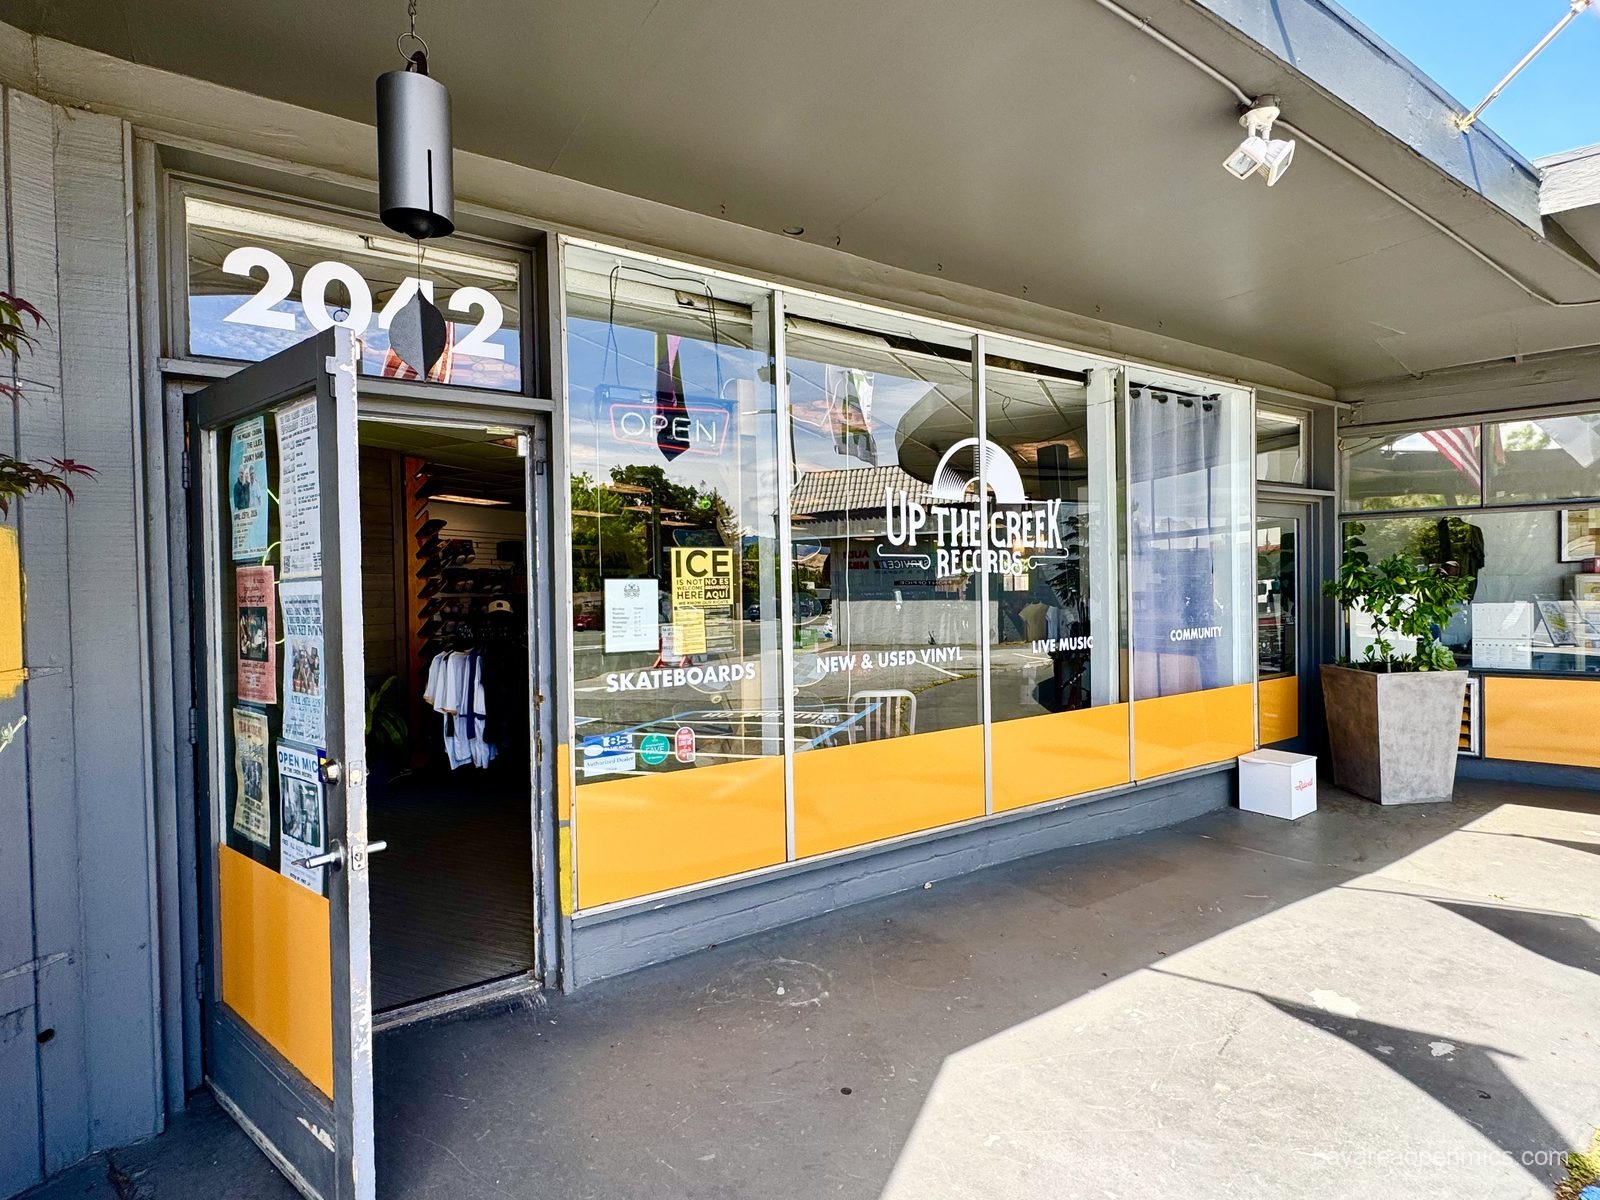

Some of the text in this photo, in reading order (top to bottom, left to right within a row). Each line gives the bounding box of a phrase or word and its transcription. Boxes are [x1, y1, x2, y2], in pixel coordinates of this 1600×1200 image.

[620, 411, 717, 445] OPEN
[884, 486, 1063, 549] UP THE CREEK
[675, 549, 730, 578] ICE
[936, 548, 1023, 579] RECORDS
[676, 590, 704, 600] HERE
[1032, 635, 1094, 655] LIVE MUSIC
[1169, 626, 1223, 642] COMMUNITY
[816, 646, 963, 674] NEW & USED VINYL
[605, 662, 756, 693] SKATEBOARDS
[278, 751, 318, 774] OPEN MIC
